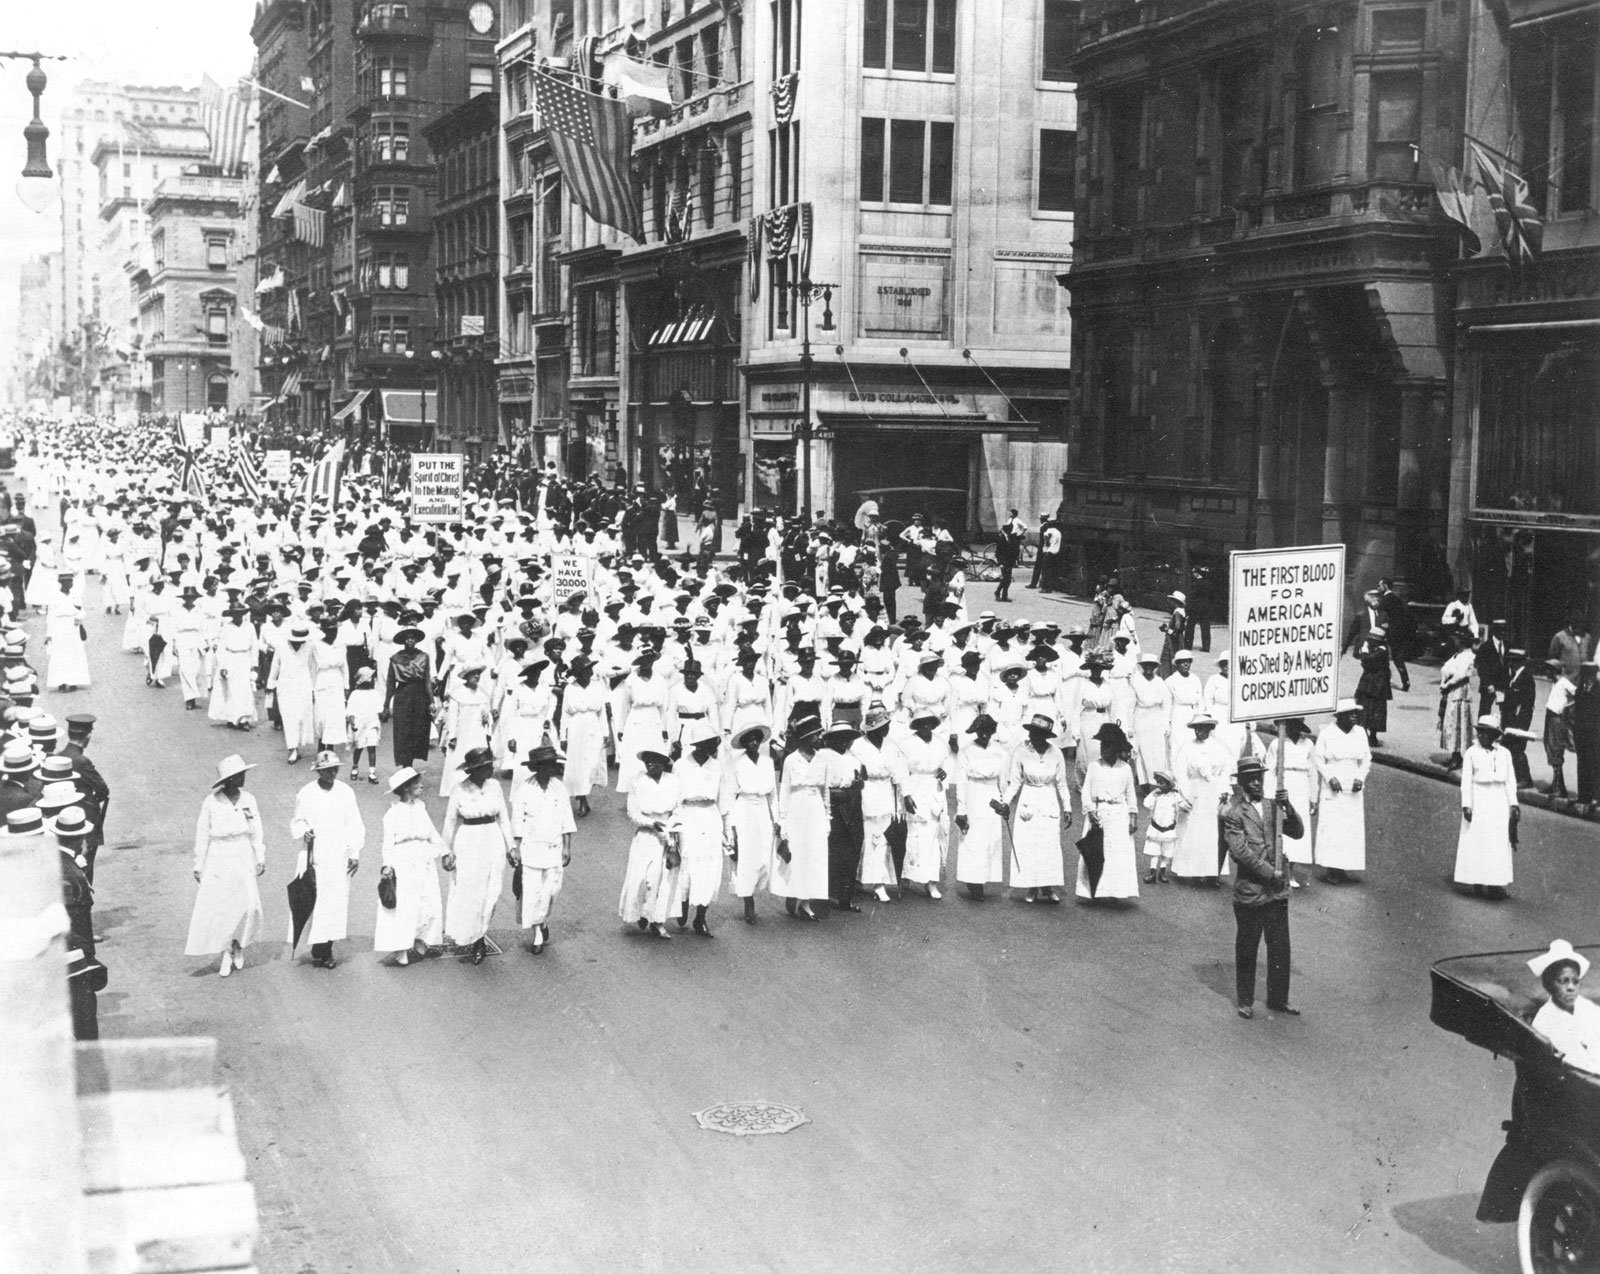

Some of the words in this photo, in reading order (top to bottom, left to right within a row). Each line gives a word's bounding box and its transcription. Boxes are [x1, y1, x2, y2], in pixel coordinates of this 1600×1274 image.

[877, 285, 932, 297] ESTABLISHED
[849, 392, 876, 403] DAVIS
[419, 461, 437, 470] PUT
[440, 461, 456, 470] THE
[414, 472, 433, 484] Spirit
[440, 472, 460, 483] Christ
[422, 485, 436, 496] the
[436, 485, 461, 499] Making
[414, 504, 442, 516] Execution
[563, 560, 578, 568] WE
[558, 569, 582, 577] HAVE
[1242, 568, 1267, 587] THE
[1270, 565, 1300, 586] FIRST
[1302, 562, 1336, 583] BLOOD
[1270, 588, 1304, 600] FOR
[1247, 602, 1323, 624] AMERICAN
[1239, 623, 1333, 648] INDEPENDENCE
[1239, 655, 1258, 676] Was
[1259, 653, 1280, 675] Shed
[1283, 652, 1295, 676] By
[1295, 650, 1303, 672] A
[1304, 648, 1333, 673] Negro
[1241, 680, 1286, 702] CRISPUS
[1288, 675, 1330, 698] ATTUCKS
